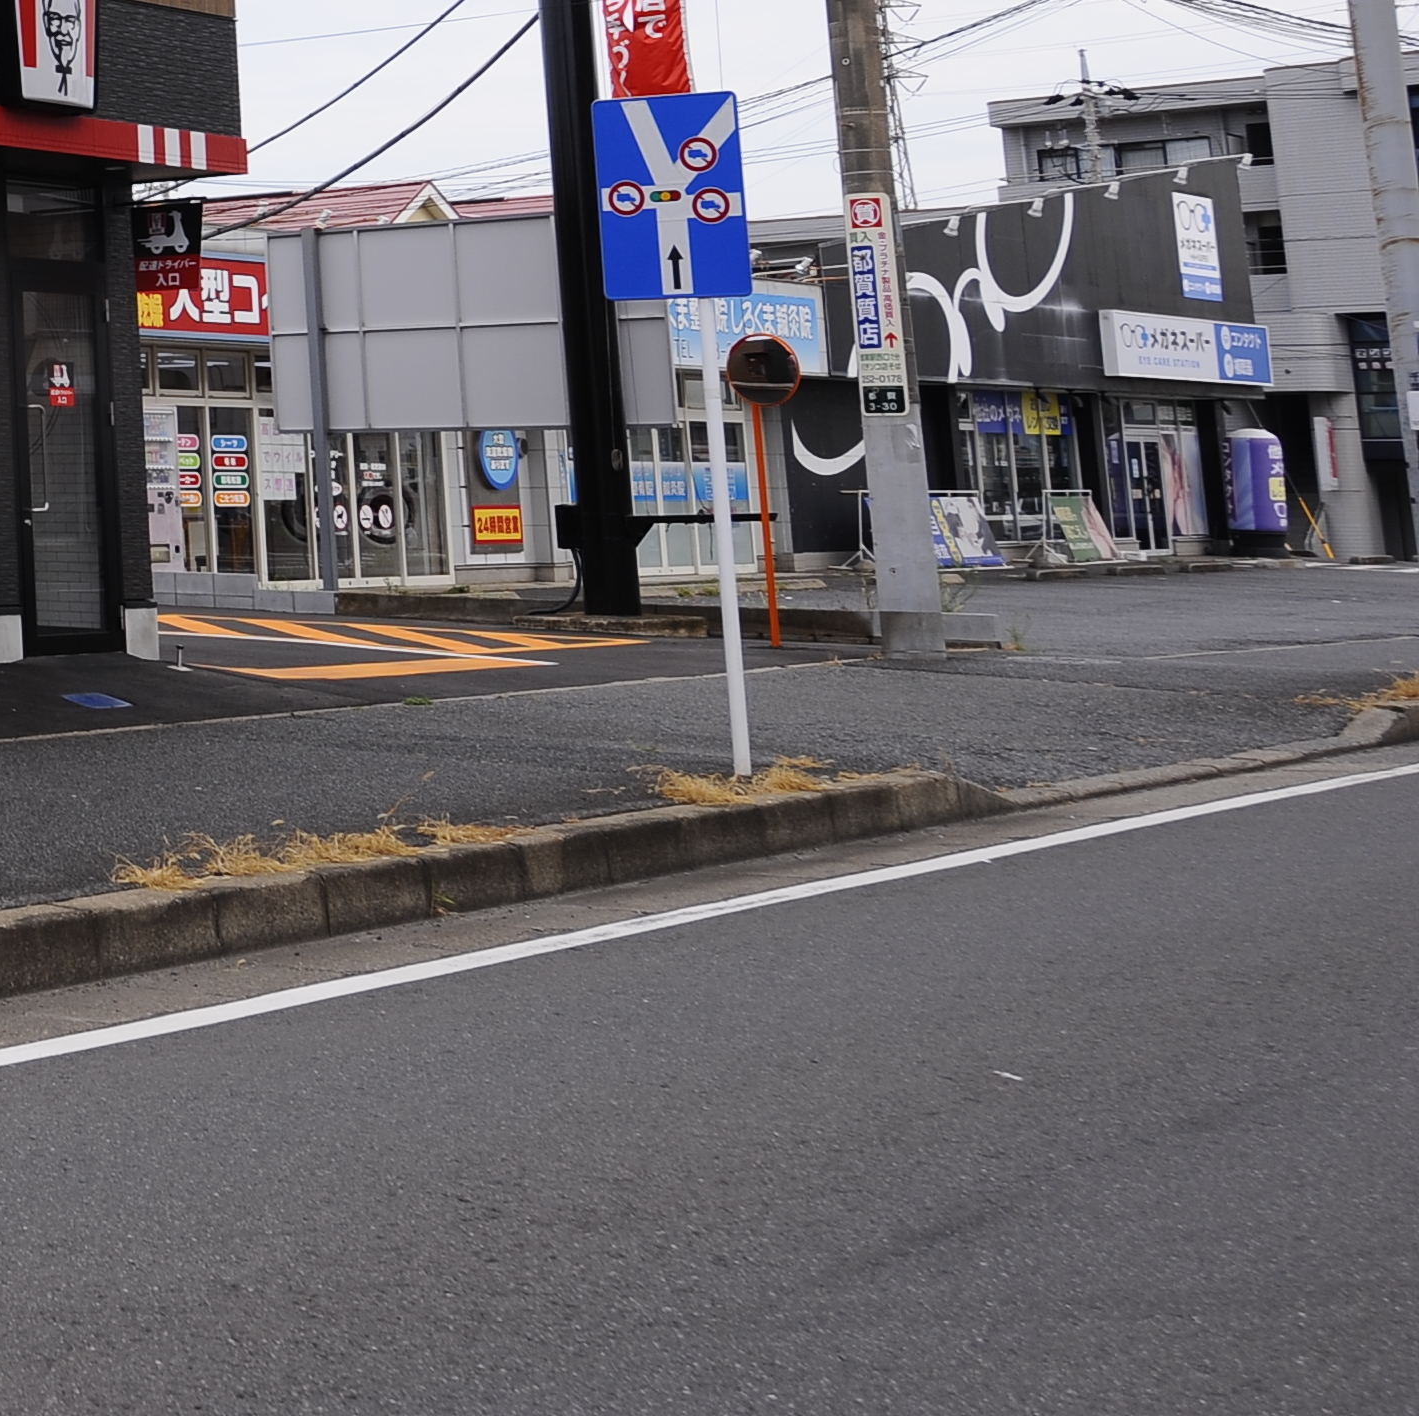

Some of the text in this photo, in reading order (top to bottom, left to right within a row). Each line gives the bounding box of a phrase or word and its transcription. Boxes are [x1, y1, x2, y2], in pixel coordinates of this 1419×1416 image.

[155, 273, 180, 287] 入口
[169, 268, 269, 325] 大型コ
[854, 249, 880, 347] 都賀質店
[674, 337, 695, 359] TEL
[1150, 327, 1211, 353] メガネスーパー
[1231, 331, 1263, 350] コンタクト
[869, 402, 898, 411] 3-30
[476, 515, 520, 534] 24時間営業
